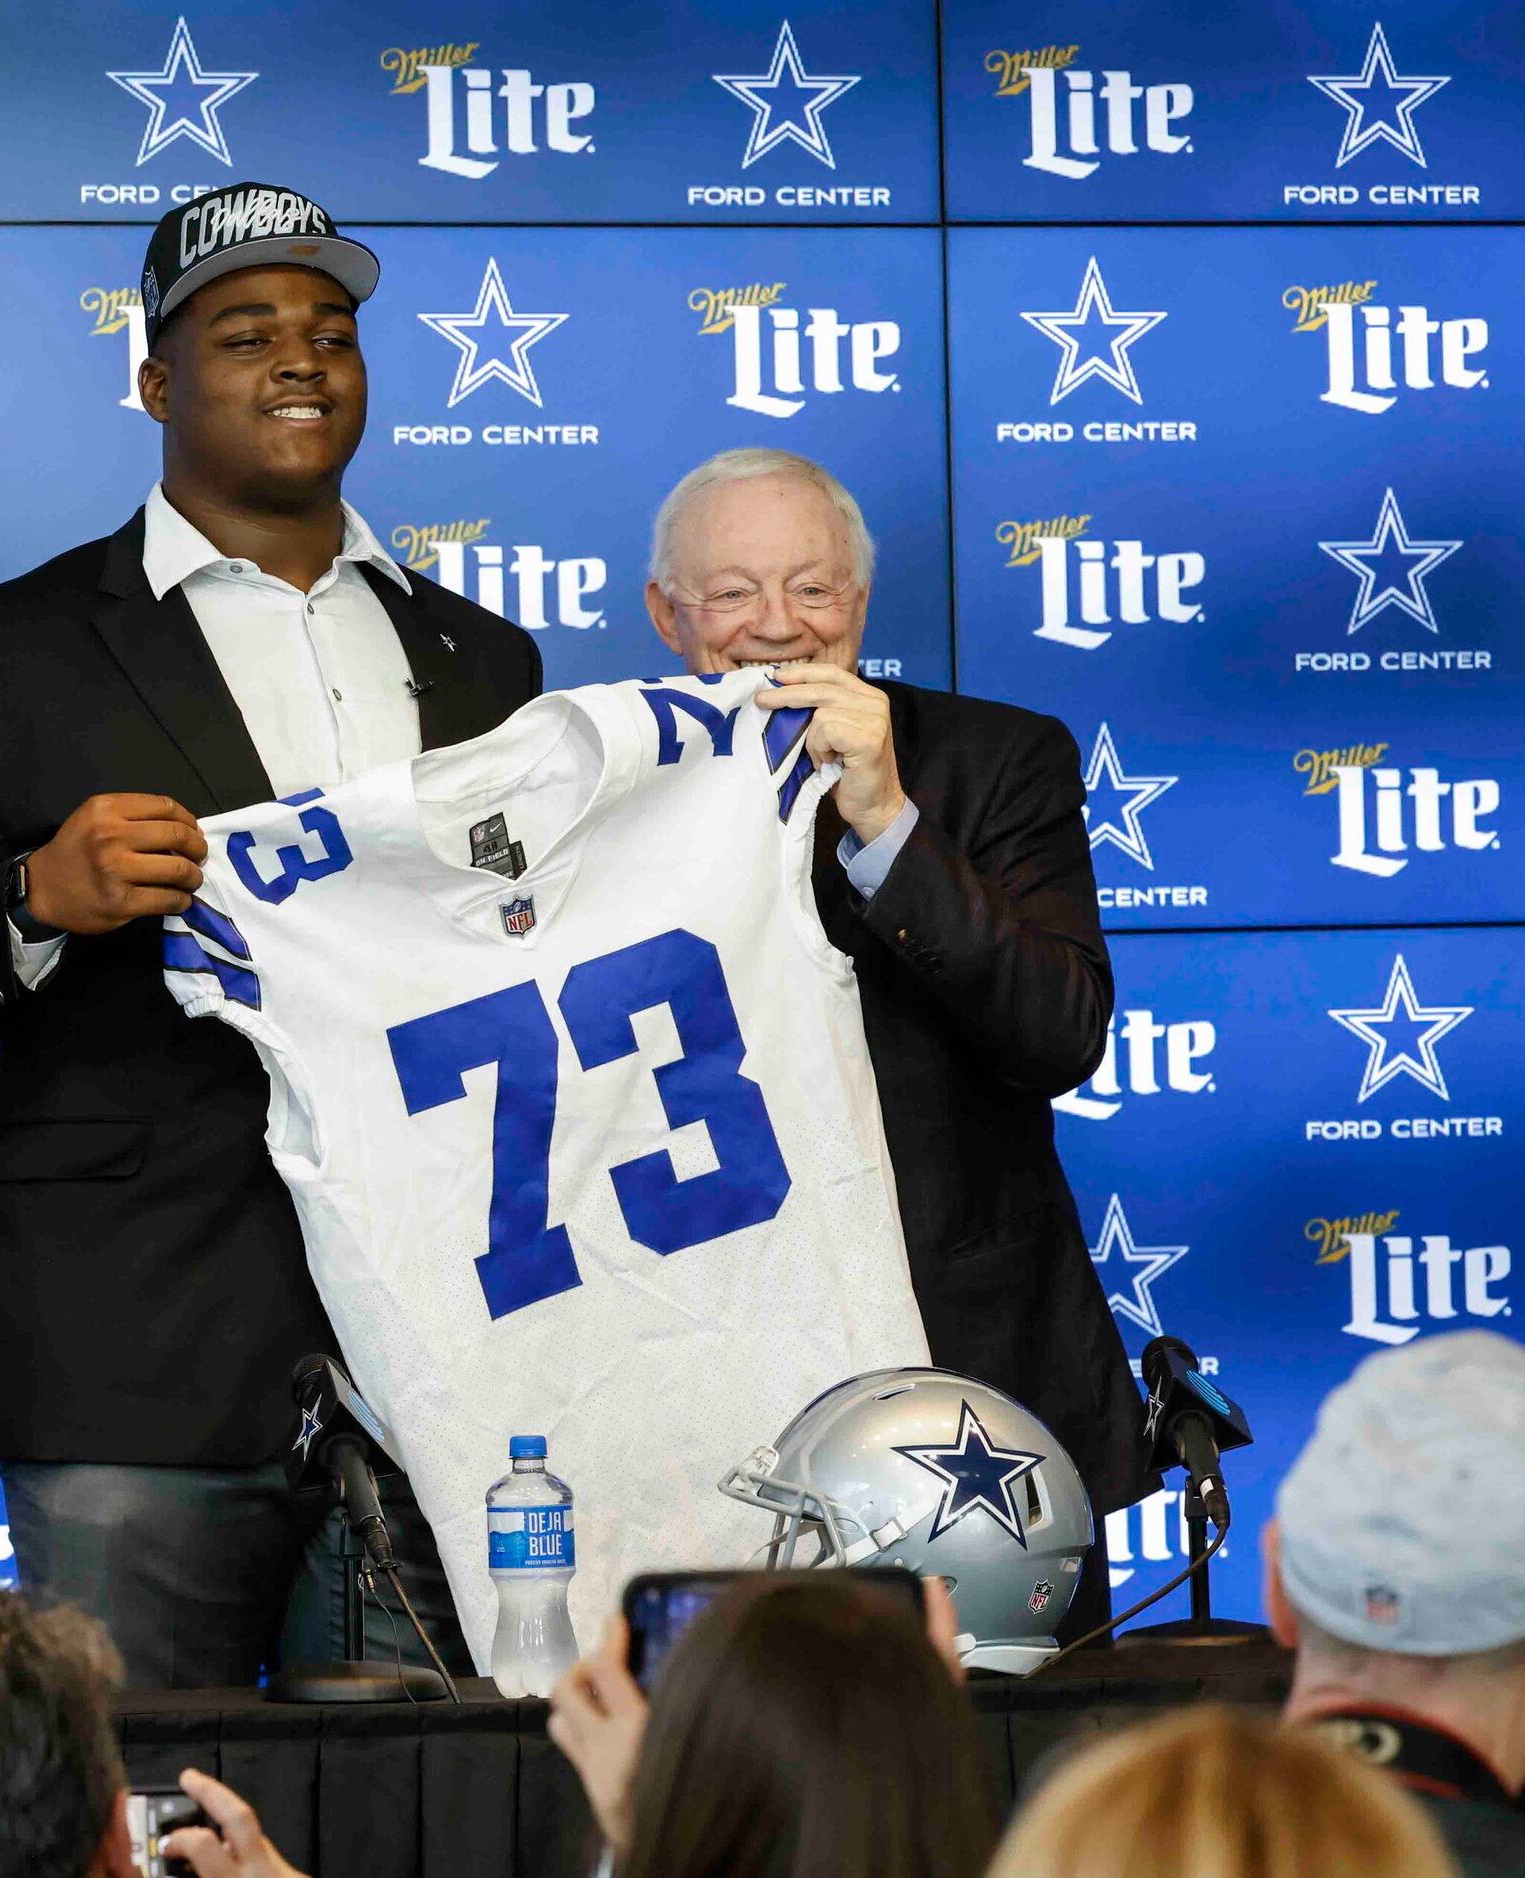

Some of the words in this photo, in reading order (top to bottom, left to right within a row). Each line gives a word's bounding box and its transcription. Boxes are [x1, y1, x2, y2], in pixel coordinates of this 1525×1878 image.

[381, 43, 480, 95] Miller
[985, 44, 1080, 95] Miller
[416, 65, 596, 178] Lite
[1021, 68, 1194, 179] Lite
[81, 185, 160, 205] FORD
[687, 187, 765, 206] FORD
[776, 187, 890, 206] CENTER
[1284, 186, 1358, 204] FORD
[1369, 186, 1480, 205] CENTER
[179, 189, 327, 270] COWBOYS
[687, 283, 786, 334] Miller
[1283, 280, 1377, 333] Miller
[723, 305, 901, 418] Lite
[1316, 303, 1489, 414] Lite
[394, 427, 472, 445] FORD
[483, 426, 599, 445] CENTER
[997, 423, 1073, 441] FORD
[1084, 422, 1196, 441] CENTER
[392, 519, 490, 570] Miller
[996, 514, 1092, 568] Miller
[1032, 536, 1205, 650] Lite
[1295, 653, 1370, 671] FORD
[1381, 651, 1491, 670] CENTER
[1294, 743, 1390, 795] Miller
[1326, 765, 1501, 878] Lite
[507, 912, 533, 931] NFL
[1097, 887, 1207, 907] CENTER
[387, 928, 792, 1321] 73
[1306, 1120, 1382, 1140] FORD
[1392, 1117, 1503, 1137] CENTER
[1305, 1210, 1400, 1265] Miller
[528, 1511, 562, 1534] DEJA
[529, 1533, 563, 1557] BLUE
